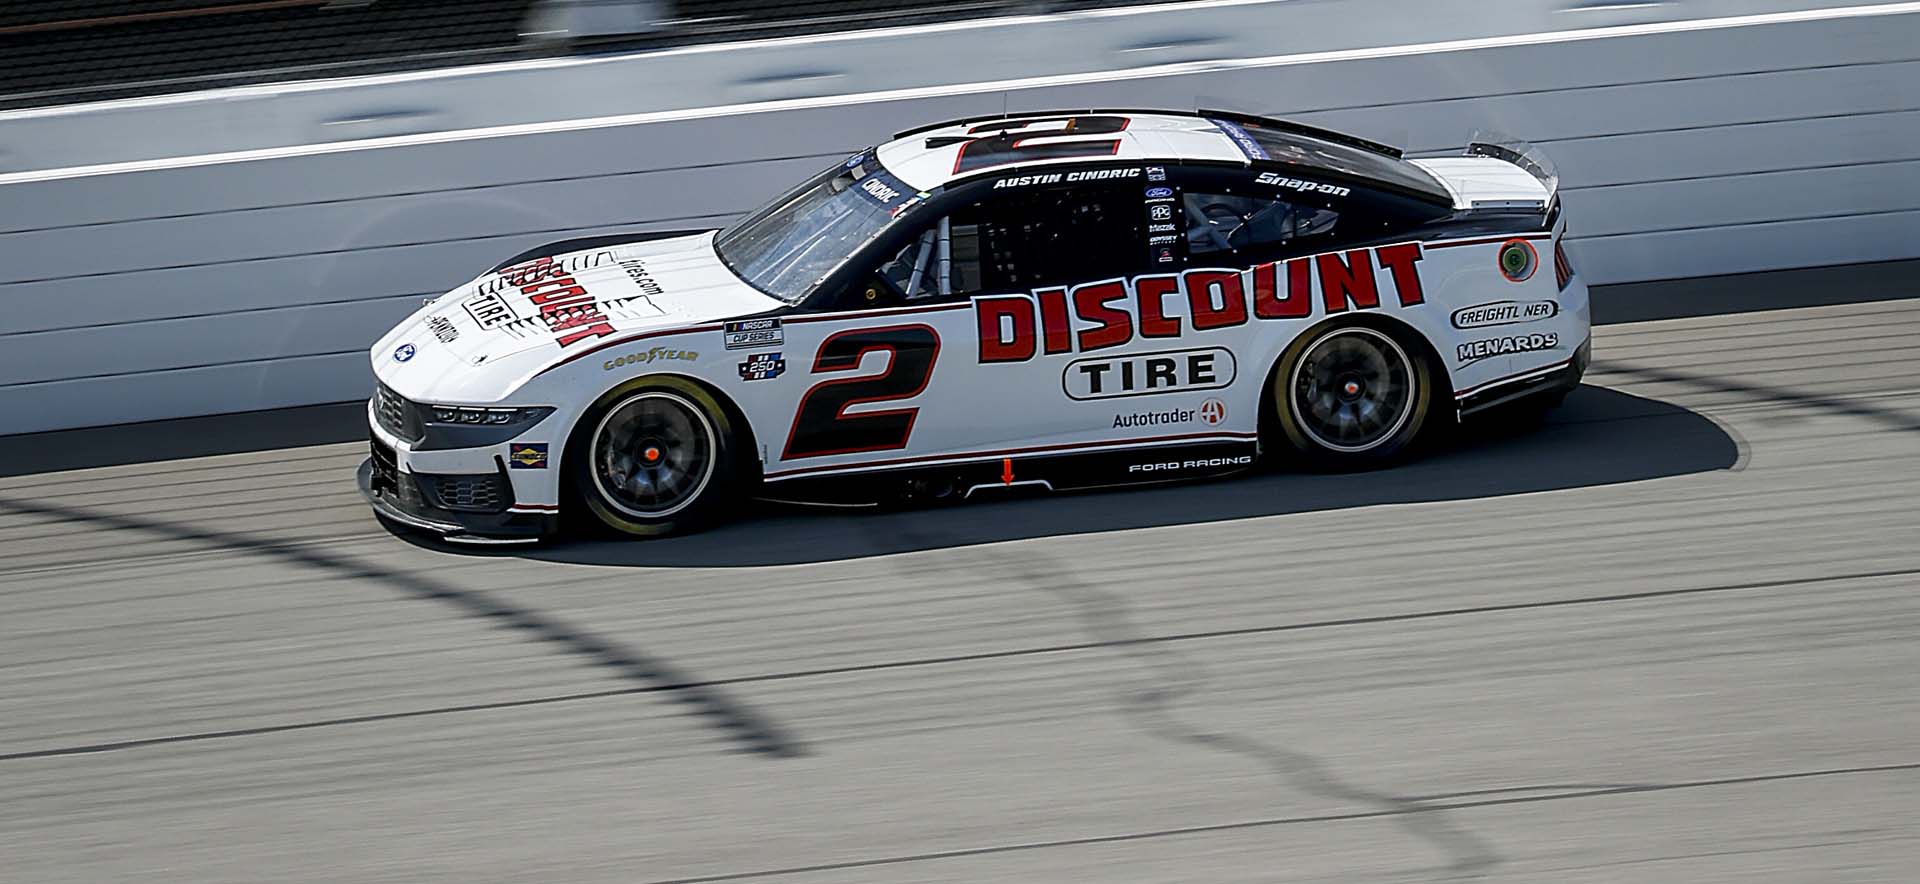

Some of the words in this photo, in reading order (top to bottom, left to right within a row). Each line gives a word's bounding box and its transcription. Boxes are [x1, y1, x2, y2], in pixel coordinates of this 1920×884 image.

[862, 178, 900, 203] CINDRIC
[993, 173, 1062, 189] AUSTIN
[1066, 168, 1141, 182] CINDRIC
[1255, 172, 1350, 196] Snap-on
[618, 259, 665, 296] tires.com
[469, 294, 511, 326] TIRE
[977, 242, 1425, 364] DISCOUNT
[1460, 304, 1549, 324] FREIGHTLNER
[733, 333, 748, 342] CUP
[749, 331, 774, 340] SERIES
[743, 320, 773, 329] NASCAR
[603, 347, 699, 371] GOODYEAR
[1456, 332, 1559, 362] MENARDS
[750, 360, 775, 372] 250
[1080, 354, 1215, 393] TIRE
[780, 323, 941, 461] 2
[1112, 408, 1196, 428] Autotrader
[1128, 462, 1179, 472] FORD
[1183, 456, 1251, 468] RACING
